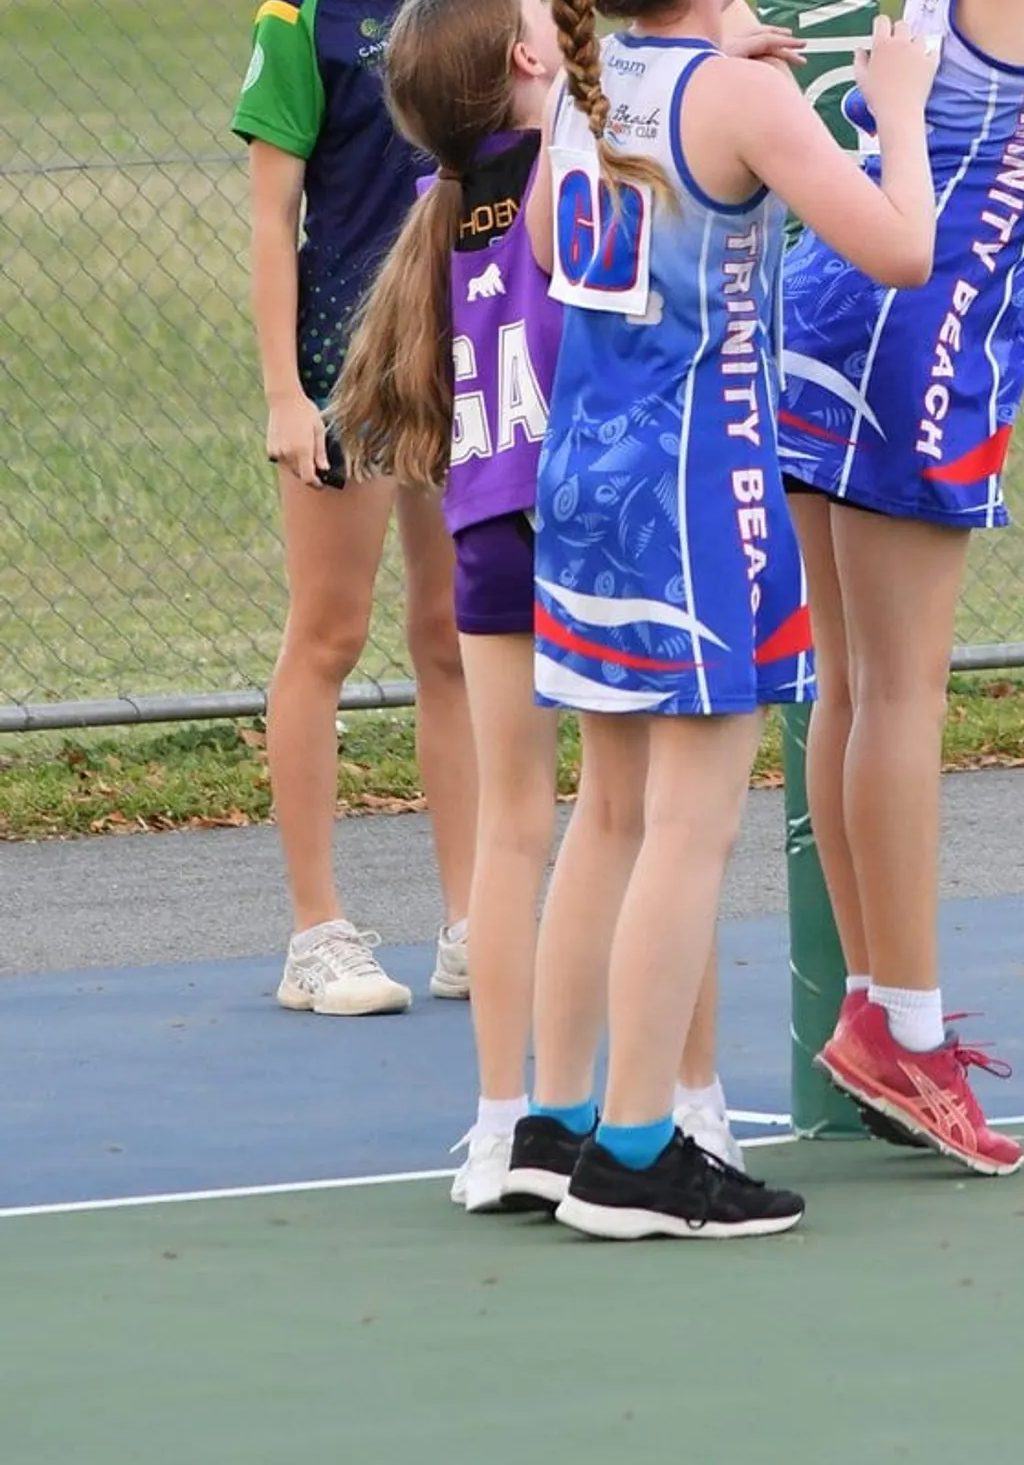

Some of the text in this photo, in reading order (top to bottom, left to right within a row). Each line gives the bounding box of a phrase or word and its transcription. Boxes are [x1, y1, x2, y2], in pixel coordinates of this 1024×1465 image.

[557, 169, 644, 293] GD
[448, 318, 549, 466] GA
[721, 222, 768, 664] TRINITY BEA
[915, 279, 980, 460] BEACH
